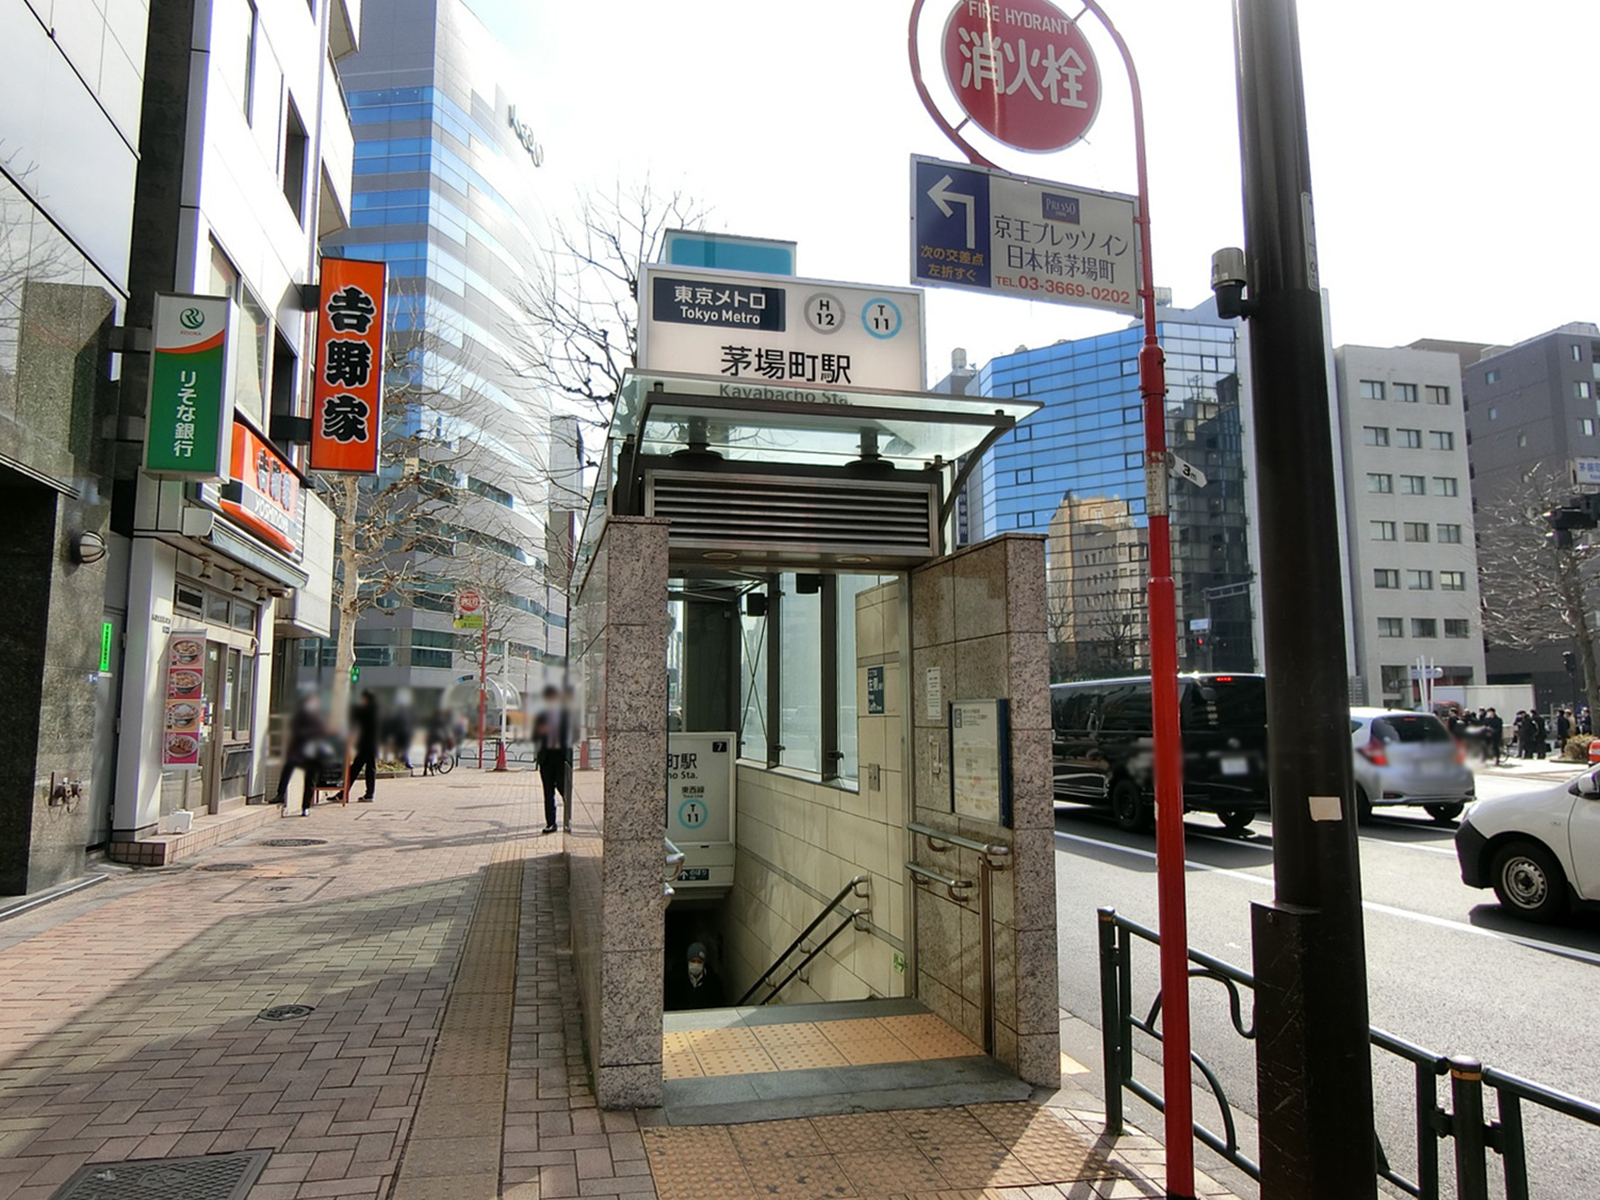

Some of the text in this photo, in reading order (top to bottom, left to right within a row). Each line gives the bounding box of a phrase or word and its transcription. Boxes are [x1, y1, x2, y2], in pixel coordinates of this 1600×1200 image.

[968, 1, 1070, 35] FIRE HYDRANT
[958, 27, 1088, 108] 消火栓
[993, 215, 1128, 257] 京王プレッソイン
[920, 245, 985, 266] 次の交差点
[1008, 245, 1116, 284] 日本橋茅場町
[928, 263, 976, 282] 左折すぐ
[674, 285, 766, 310] 東京メトロ
[819, 300, 830, 311] H
[680, 306, 761, 325] Tokyo Metro
[816, 312, 835, 326] 12
[877, 305, 885, 315] T
[873, 317, 890, 331] 11
[321, 285, 377, 444] 吉野家
[720, 345, 852, 384] 茅場町駅
[173, 370, 198, 458] りそな銀行
[687, 813, 698, 822] 11
[690, 803, 696, 812] T
